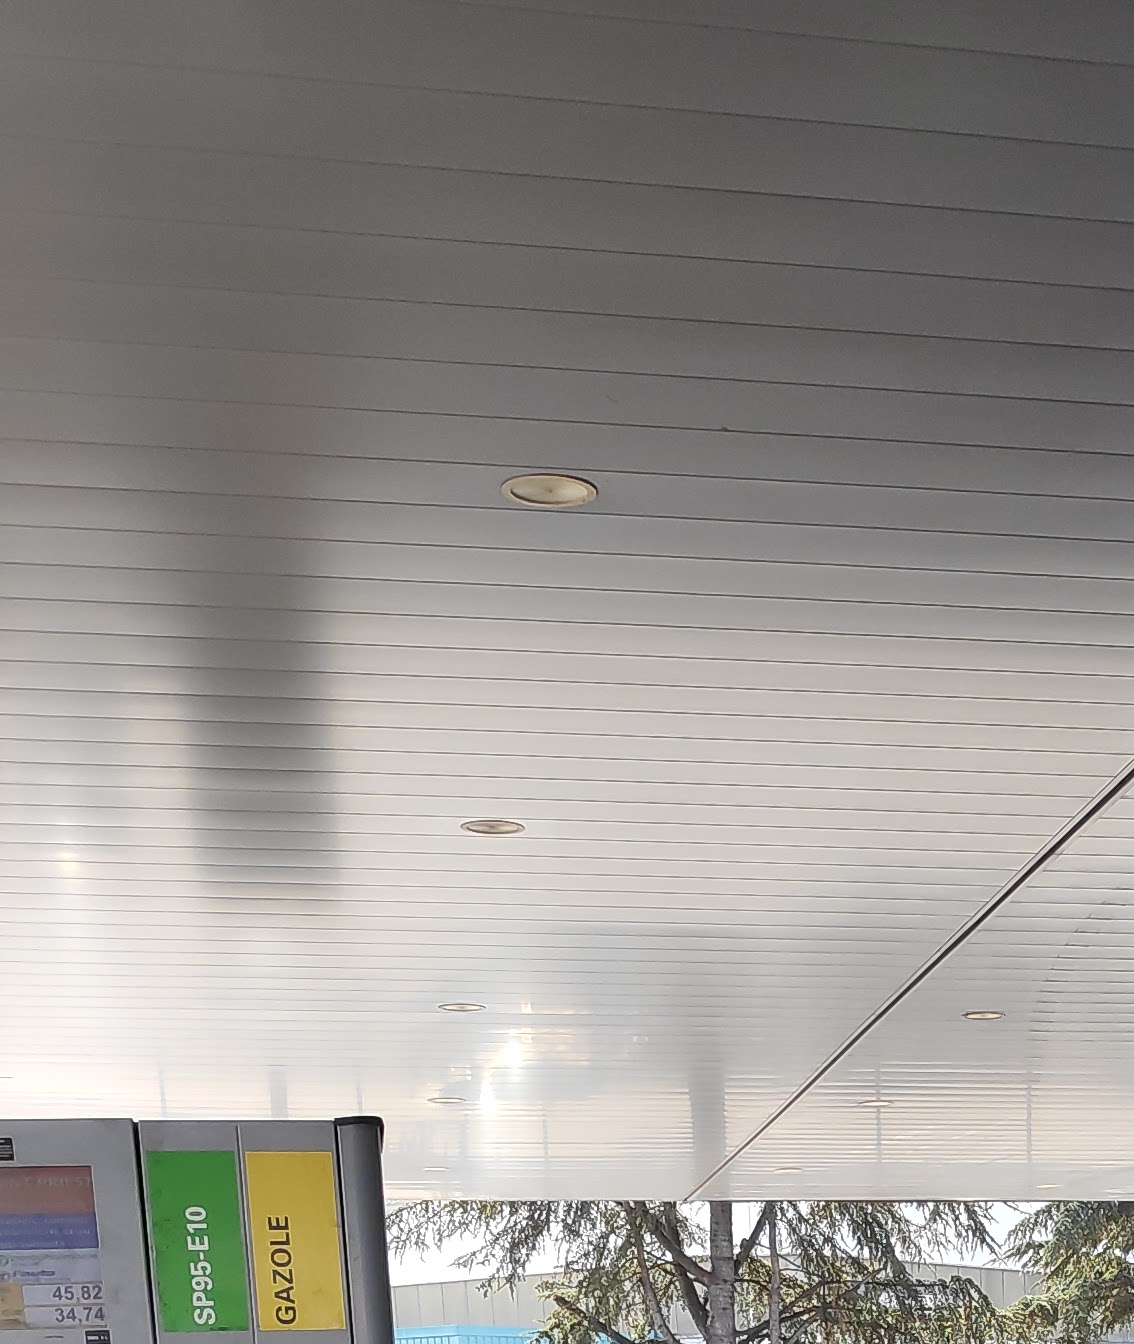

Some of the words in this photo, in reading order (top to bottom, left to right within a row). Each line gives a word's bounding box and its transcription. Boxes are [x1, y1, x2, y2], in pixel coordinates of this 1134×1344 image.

[52, 1285, 103, 1302] 45,82
[185, 1206, 216, 1325] SP95-E10
[267, 1215, 297, 1325] GAZOLE
[54, 1306, 105, 1324] 34,74
